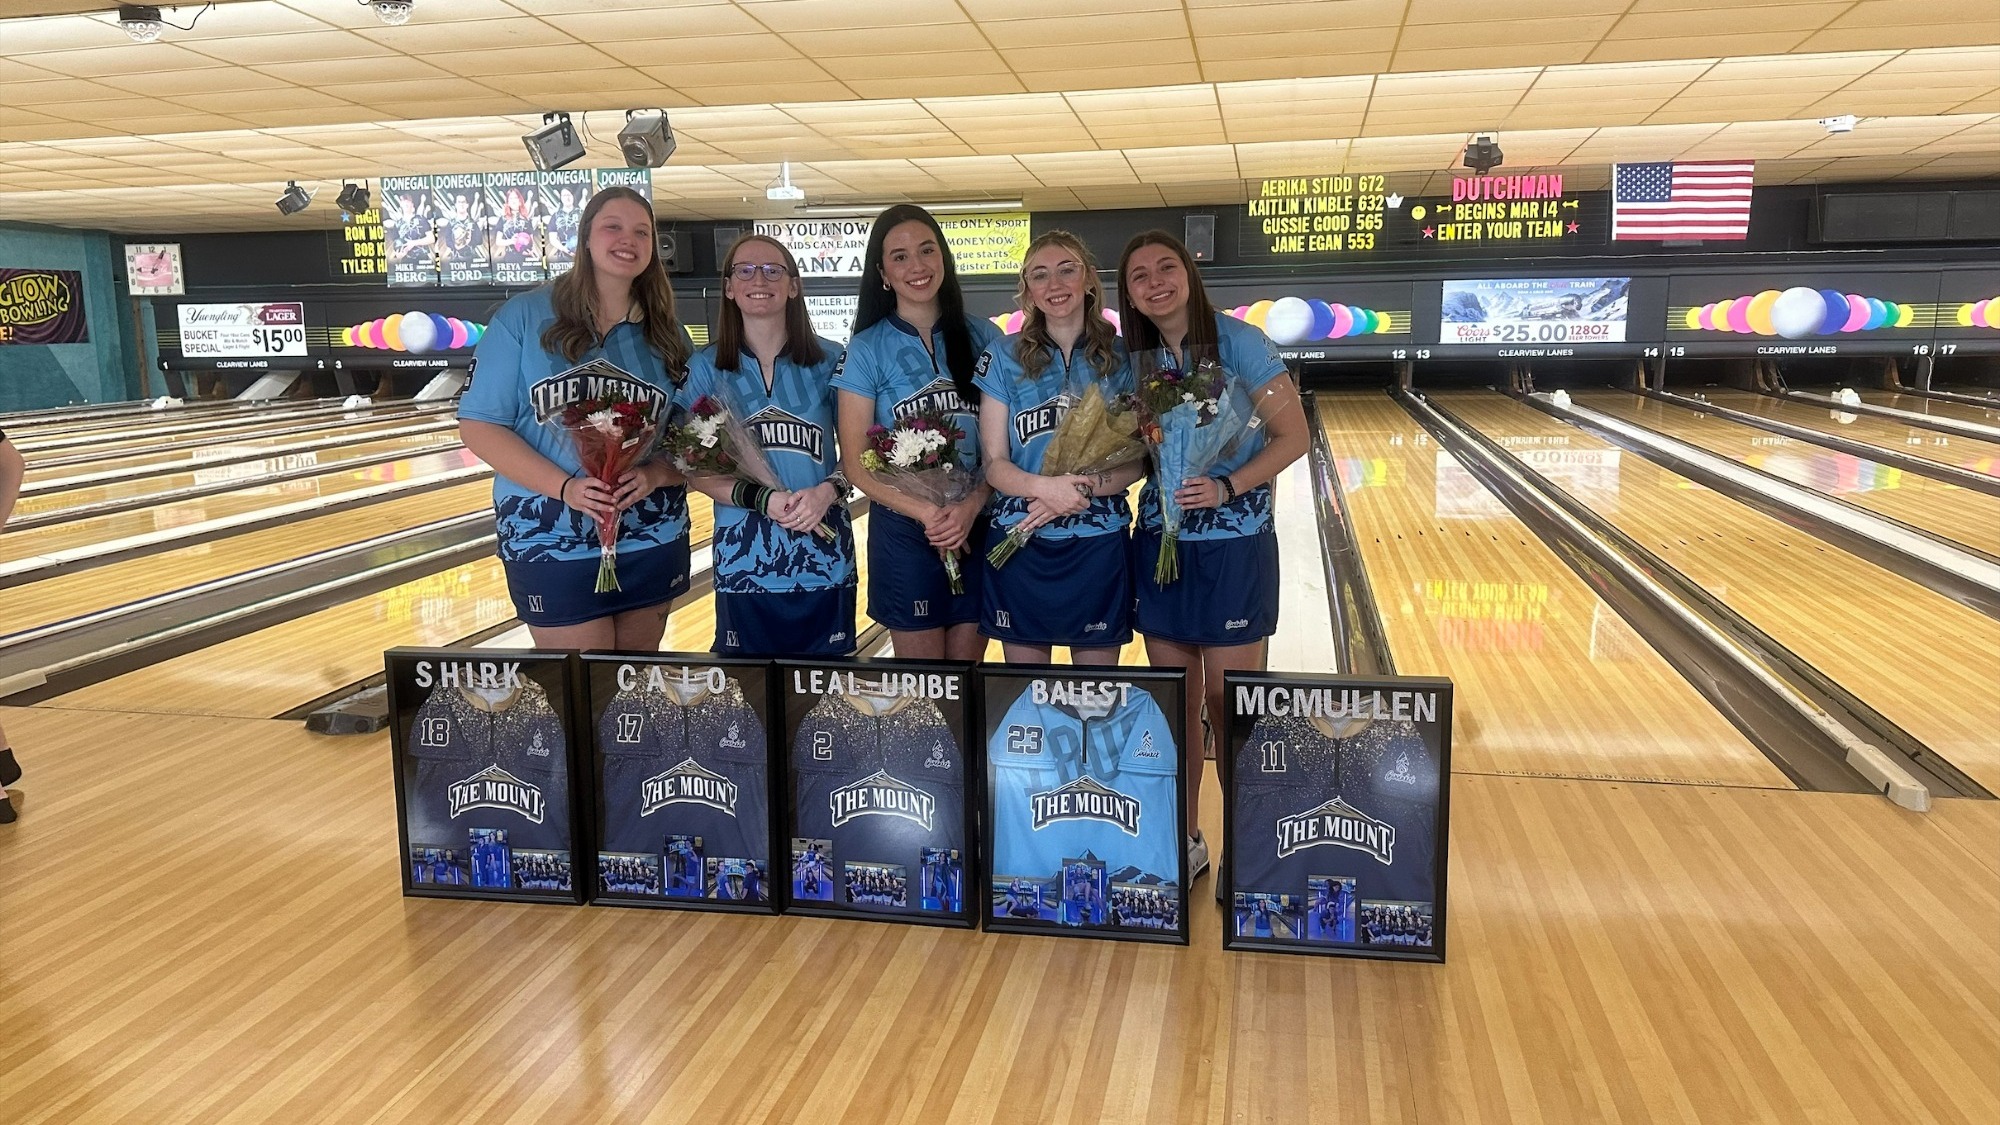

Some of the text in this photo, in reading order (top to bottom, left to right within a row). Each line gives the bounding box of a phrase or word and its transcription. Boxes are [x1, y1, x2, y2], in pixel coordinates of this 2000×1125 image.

[384, 176, 429, 190] DONEGAL
[436, 174, 482, 189] DONEGAL
[488, 173, 536, 187] DONEGAL
[542, 170, 590, 185] DONEGAL
[602, 172, 648, 185] DONEGAL
[1262, 175, 1384, 196] AERIKA STIDD 672
[1453, 175, 1562, 201] DUTCHMAN
[1249, 195, 1384, 216] KAITLIN KIMBLE 632
[1456, 201, 1558, 221] BEGINS MAR 14
[756, 223, 869, 236] DID YOU KNOW
[940, 221, 958, 229] THE
[960, 219, 992, 228] ONLY
[1263, 214, 1383, 234] GUSSIE GOOD 565
[1438, 220, 1563, 240] ENTER YOUR TEAM
[345, 226, 385, 241] RON MO
[354, 243, 375, 257] BOB
[837, 240, 865, 248] EARN
[1271, 233, 1374, 252] JANE EGAN 553
[130, 266, 134, 274] 9
[341, 259, 374, 274] TYLER
[450, 262, 466, 270] TOM
[798, 257, 842, 272] ANY
[955, 262, 990, 271] egister
[395, 272, 426, 282] BERG
[451, 270, 482, 281] FORD
[497, 271, 538, 281] GRICE
[0, 275, 59, 306] GLOW
[0, 297, 68, 322] BOWLING
[809, 298, 841, 306] MILLER
[186, 307, 240, 324] Yuengling
[812, 322, 837, 330] GLES:
[1457, 325, 1490, 337] Coors
[1493, 324, 1567, 341] $25.00
[1570, 325, 1608, 335] 128OZ
[184, 330, 218, 339] BUCKET
[185, 343, 221, 352] SPECIAL
[1392, 350, 1406, 359] 12
[1416, 350, 1430, 359] 13
[1498, 349, 1545, 357] CLEARVIEW
[1644, 348, 1658, 357] 14
[1670, 347, 1684, 356] 15
[1758, 346, 1836, 355] CLEARVIEW LANES
[1912, 345, 1928, 355] 16
[1941, 345, 1956, 354] 17
[163, 361, 168, 369] 1
[318, 360, 324, 368] 2
[534, 377, 580, 420] THE
[897, 396, 928, 420] THE
[1017, 408, 1050, 440] THE
[761, 423, 822, 455] MOUNT
[528, 595, 544, 612] M
[914, 600, 928, 616] M
[996, 610, 1010, 627] M
[415, 661, 522, 689] SHIRK
[794, 670, 960, 700] LEAL-URIBE
[1031, 680, 1132, 707] BALEST
[1236, 686, 1436, 722] MCMULLEN
[420, 718, 449, 746] 18
[617, 713, 644, 743] 17
[814, 731, 833, 760] 2
[1007, 725, 1044, 755] 23
[1261, 740, 1286, 773] 11
[452, 781, 542, 816] THE MOUNT
[645, 776, 734, 811] THE MOUNT
[834, 787, 932, 824] THE MOUNT
[1034, 792, 1137, 829] THE MOUNT
[1281, 816, 1390, 855] THE MOUNT
